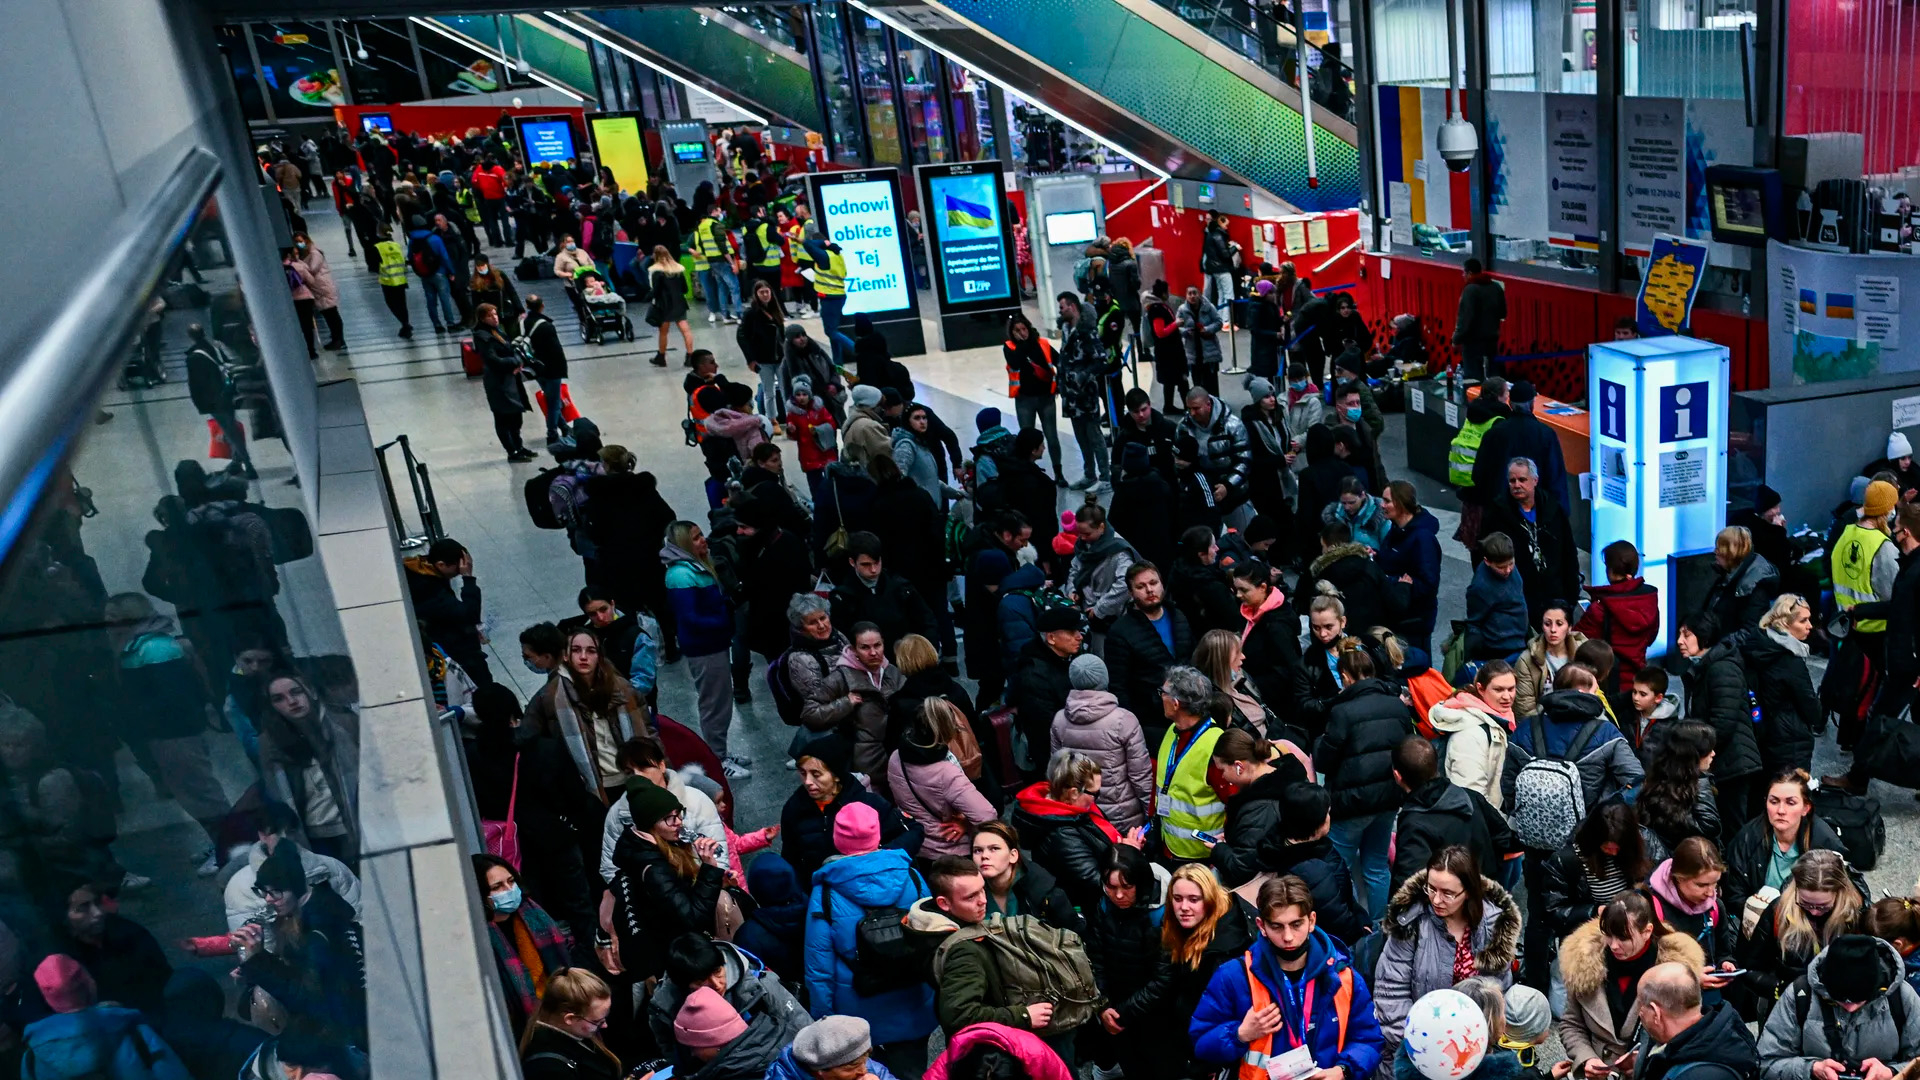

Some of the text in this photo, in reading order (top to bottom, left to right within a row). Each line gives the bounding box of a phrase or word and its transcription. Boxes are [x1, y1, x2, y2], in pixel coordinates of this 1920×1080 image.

[828, 196, 889, 215] odnowi
[834, 225, 893, 241] oblicze
[855, 250, 880, 267] Tej
[845, 274, 897, 293] Ziemi!
